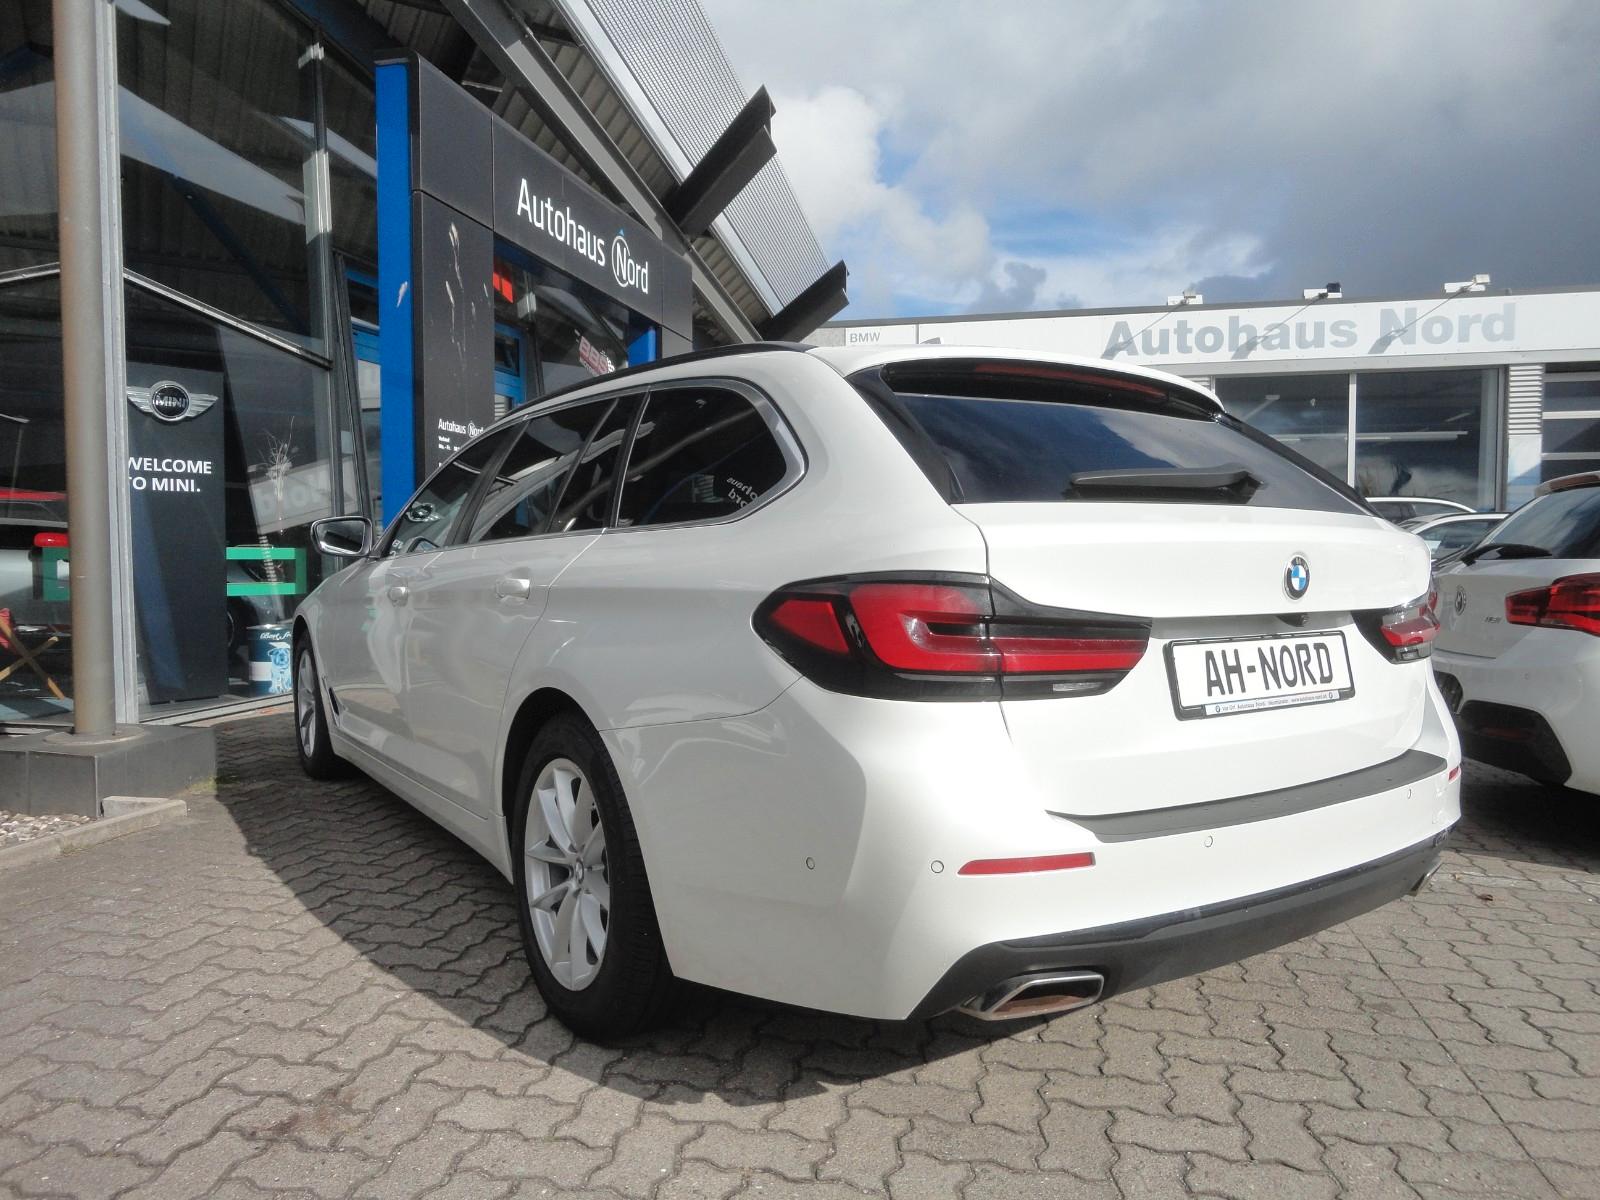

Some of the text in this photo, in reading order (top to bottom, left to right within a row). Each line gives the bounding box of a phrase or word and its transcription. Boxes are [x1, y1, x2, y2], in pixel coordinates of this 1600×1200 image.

[517, 178, 649, 294] Autohaus Nord
[850, 332, 880, 343] BMW
[1103, 302, 1516, 358] Autohaus Nord
[438, 418, 466, 434] Autohaus
[128, 457, 212, 474] WELCOME
[128, 476, 201, 492] O MINI.
[1205, 642, 1333, 697] AH-NORD
